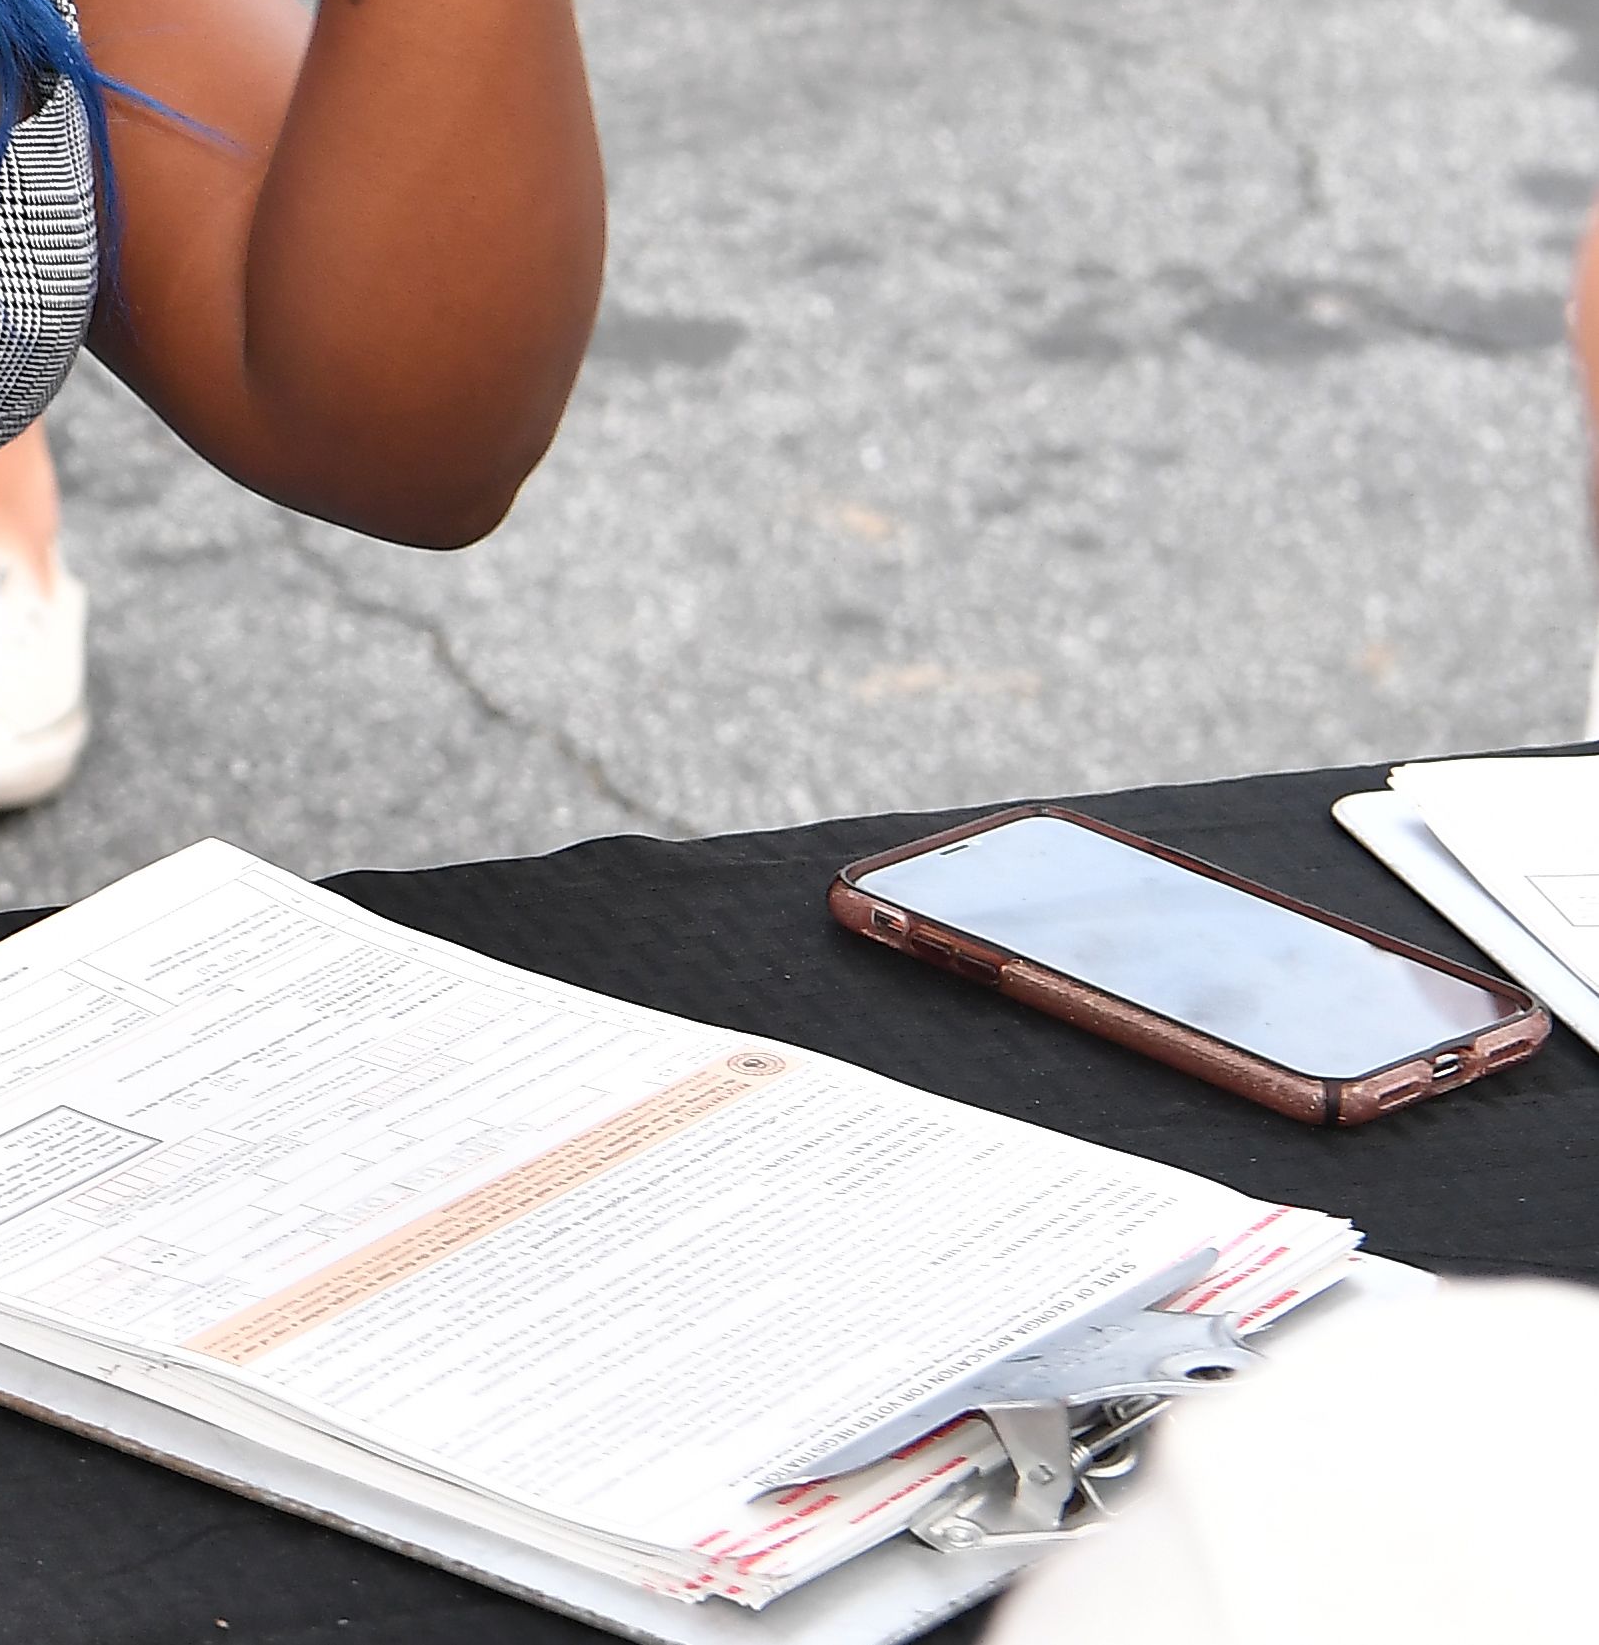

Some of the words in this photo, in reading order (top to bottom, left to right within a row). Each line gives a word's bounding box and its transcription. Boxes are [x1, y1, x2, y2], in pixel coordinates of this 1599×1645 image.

[1087, 1260, 1139, 1288] STATE
[1067, 1286, 1097, 1300] OF
[1008, 1298, 1077, 1336] GEORGIA
[926, 1333, 1018, 1385] APPLICATION
[896, 1382, 936, 1403] FOR
[850, 1400, 906, 1430] VOTER
[752, 1427, 860, 1488] REGISTRATION
